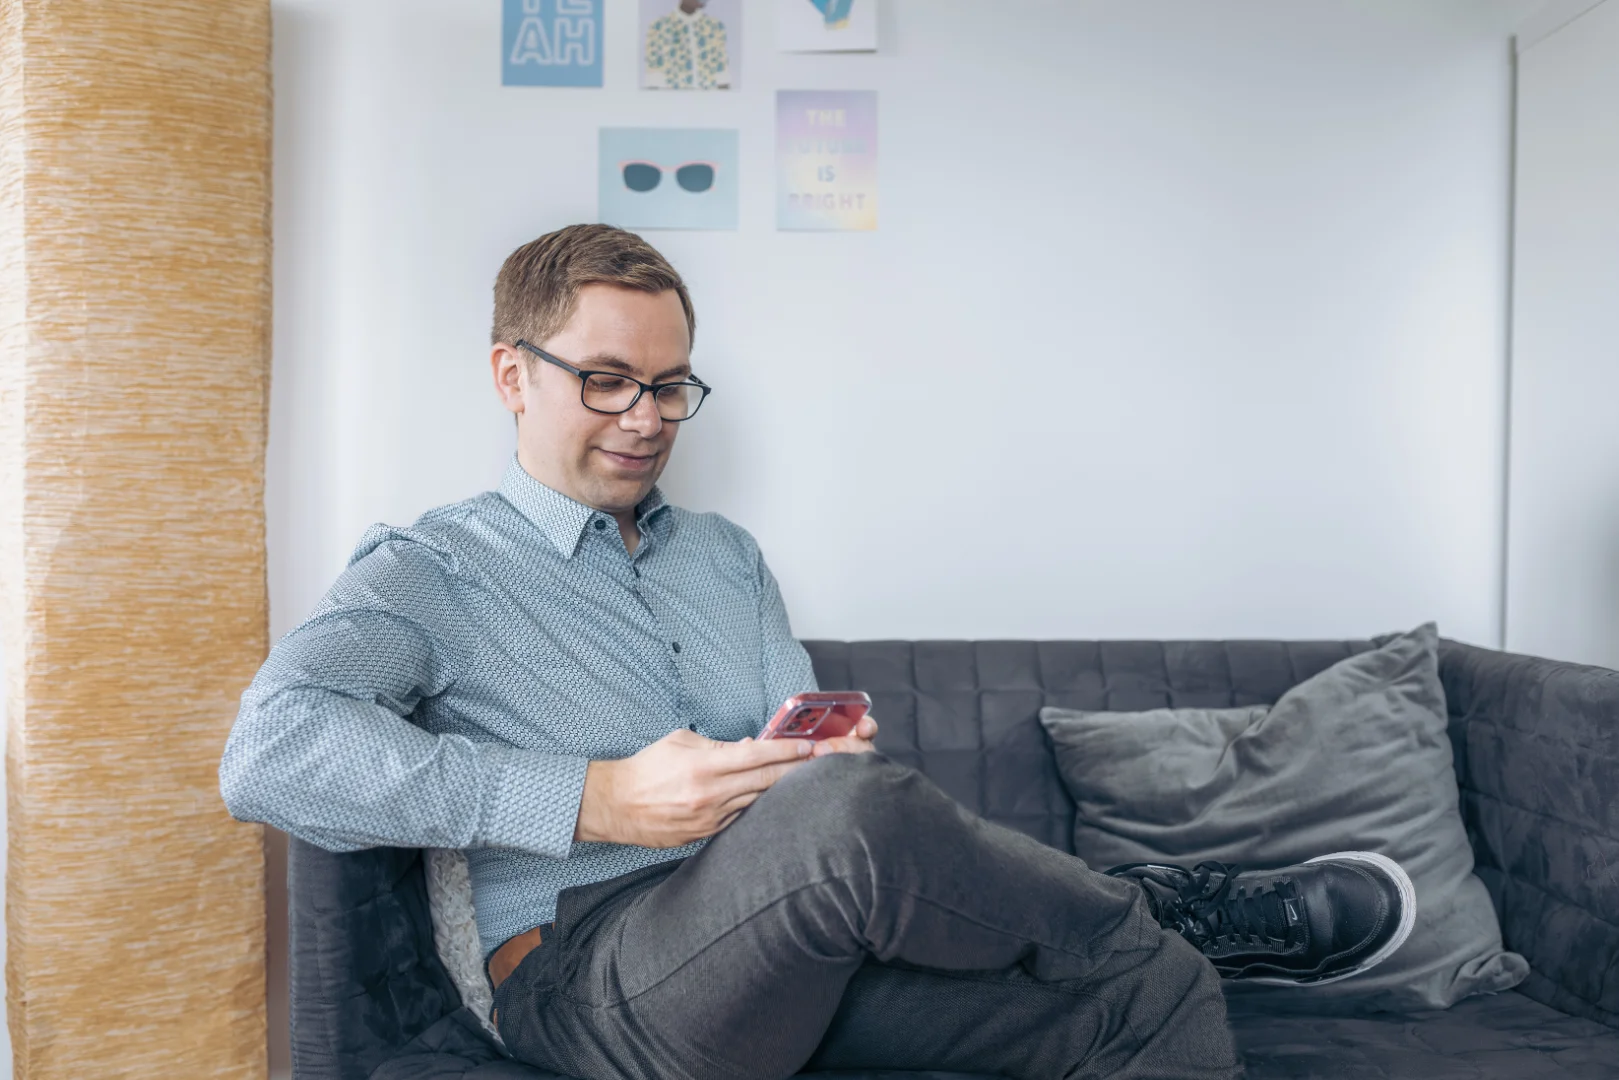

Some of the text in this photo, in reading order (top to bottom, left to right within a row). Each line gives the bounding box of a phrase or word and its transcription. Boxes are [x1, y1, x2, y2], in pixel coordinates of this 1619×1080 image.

[510, 17, 594, 65] AH
[805, 108, 847, 127] THE
[817, 164, 836, 183] IS
